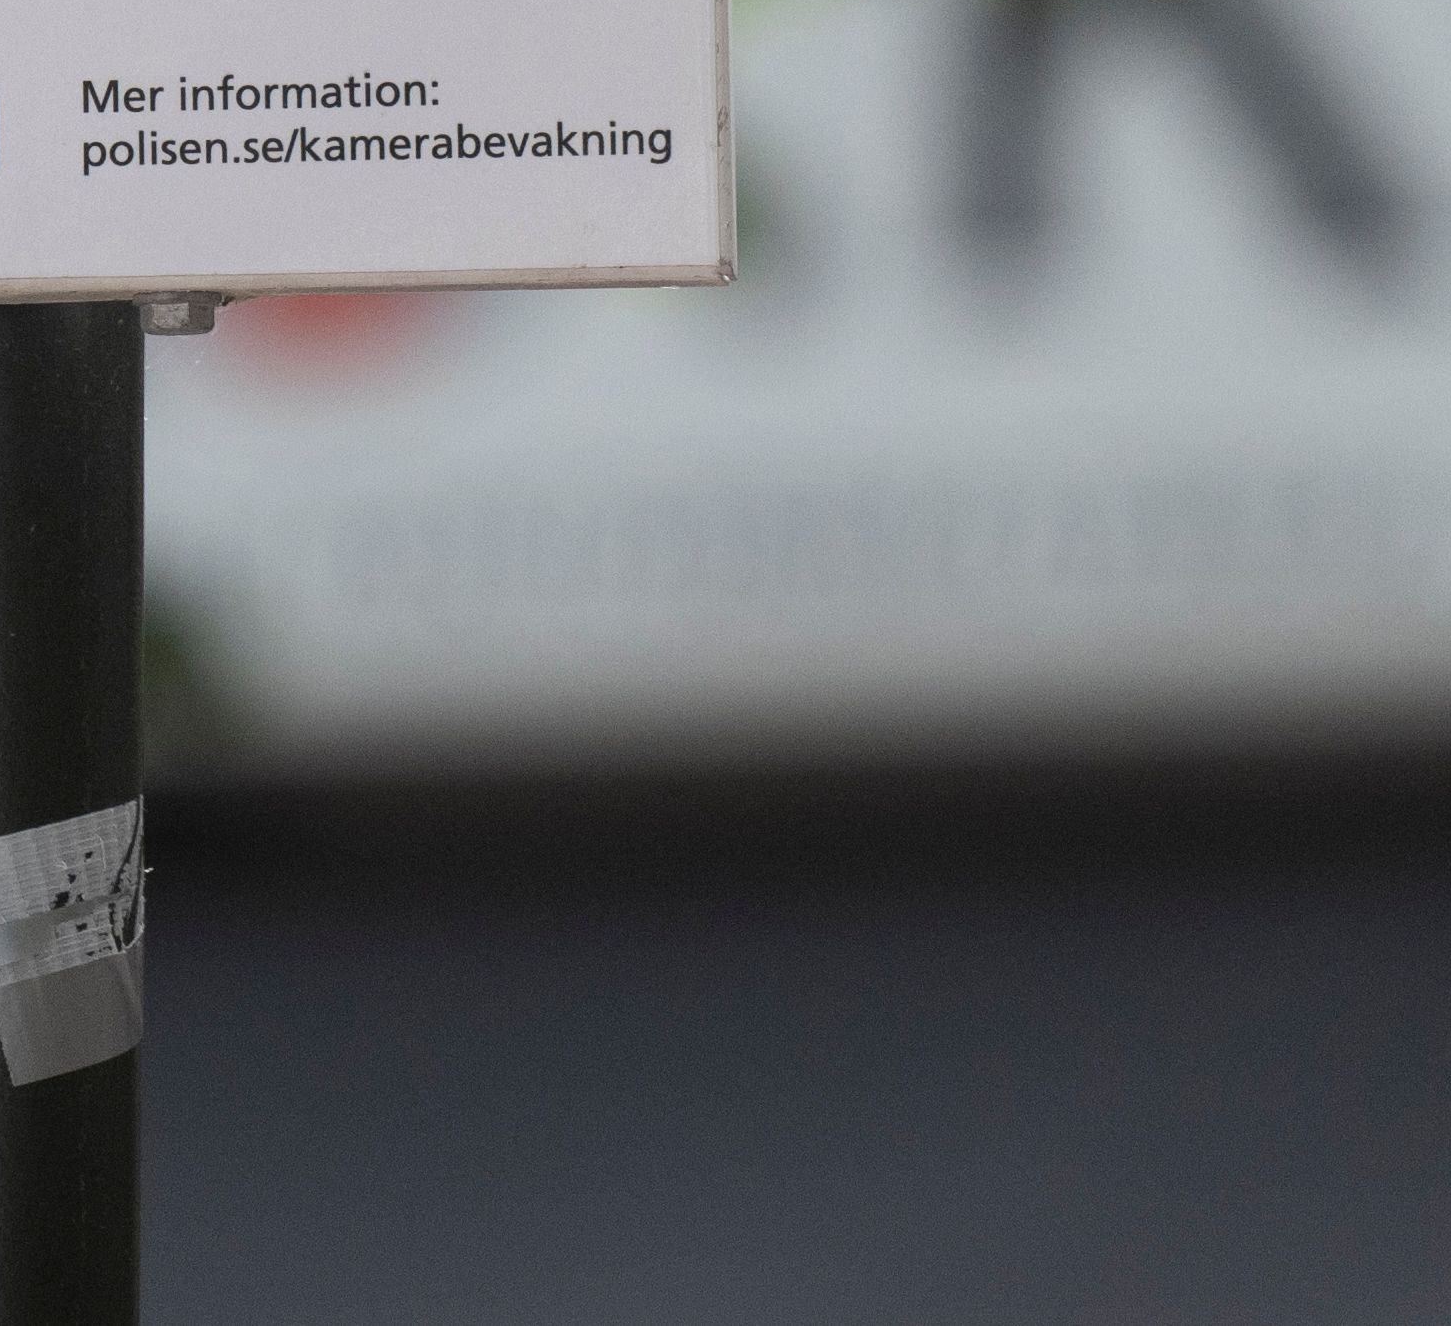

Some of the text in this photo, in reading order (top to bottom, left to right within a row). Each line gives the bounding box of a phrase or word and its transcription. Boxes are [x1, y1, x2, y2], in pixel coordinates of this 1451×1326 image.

[82, 74, 439, 114] Mer information:
[83, 120, 672, 176] polisen.se/kamerabevakning
